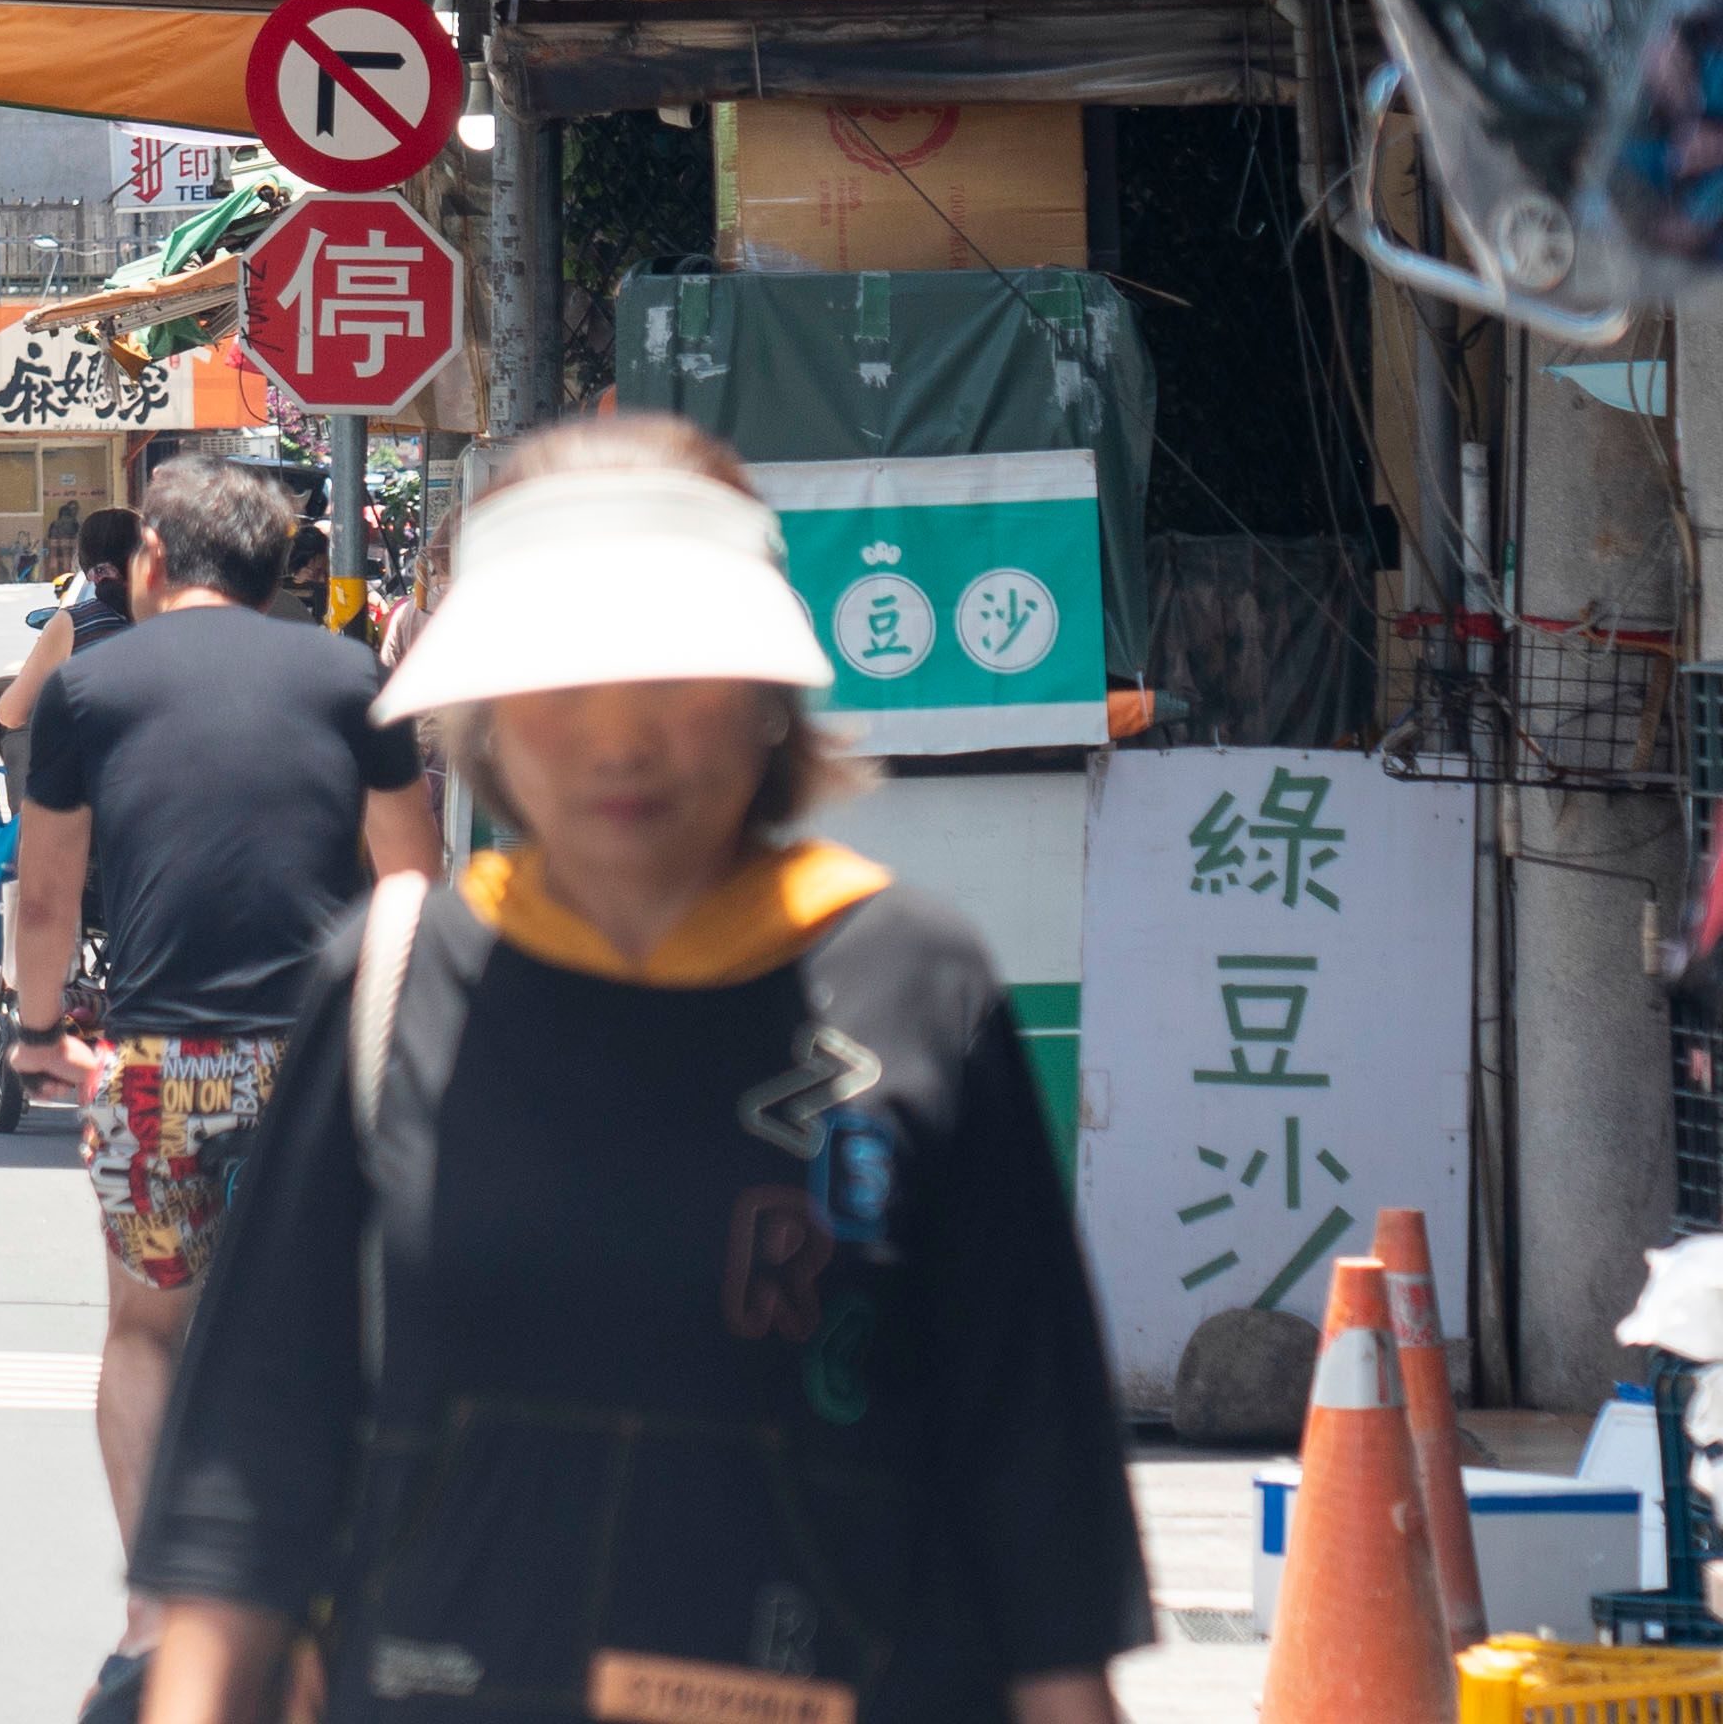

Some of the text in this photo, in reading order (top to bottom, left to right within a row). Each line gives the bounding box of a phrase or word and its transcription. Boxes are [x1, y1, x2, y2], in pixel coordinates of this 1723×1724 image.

[276, 227, 426, 379] 停
[861, 586, 1039, 660] 豆沙
[1175, 764, 1356, 1310] 綠豆沙
